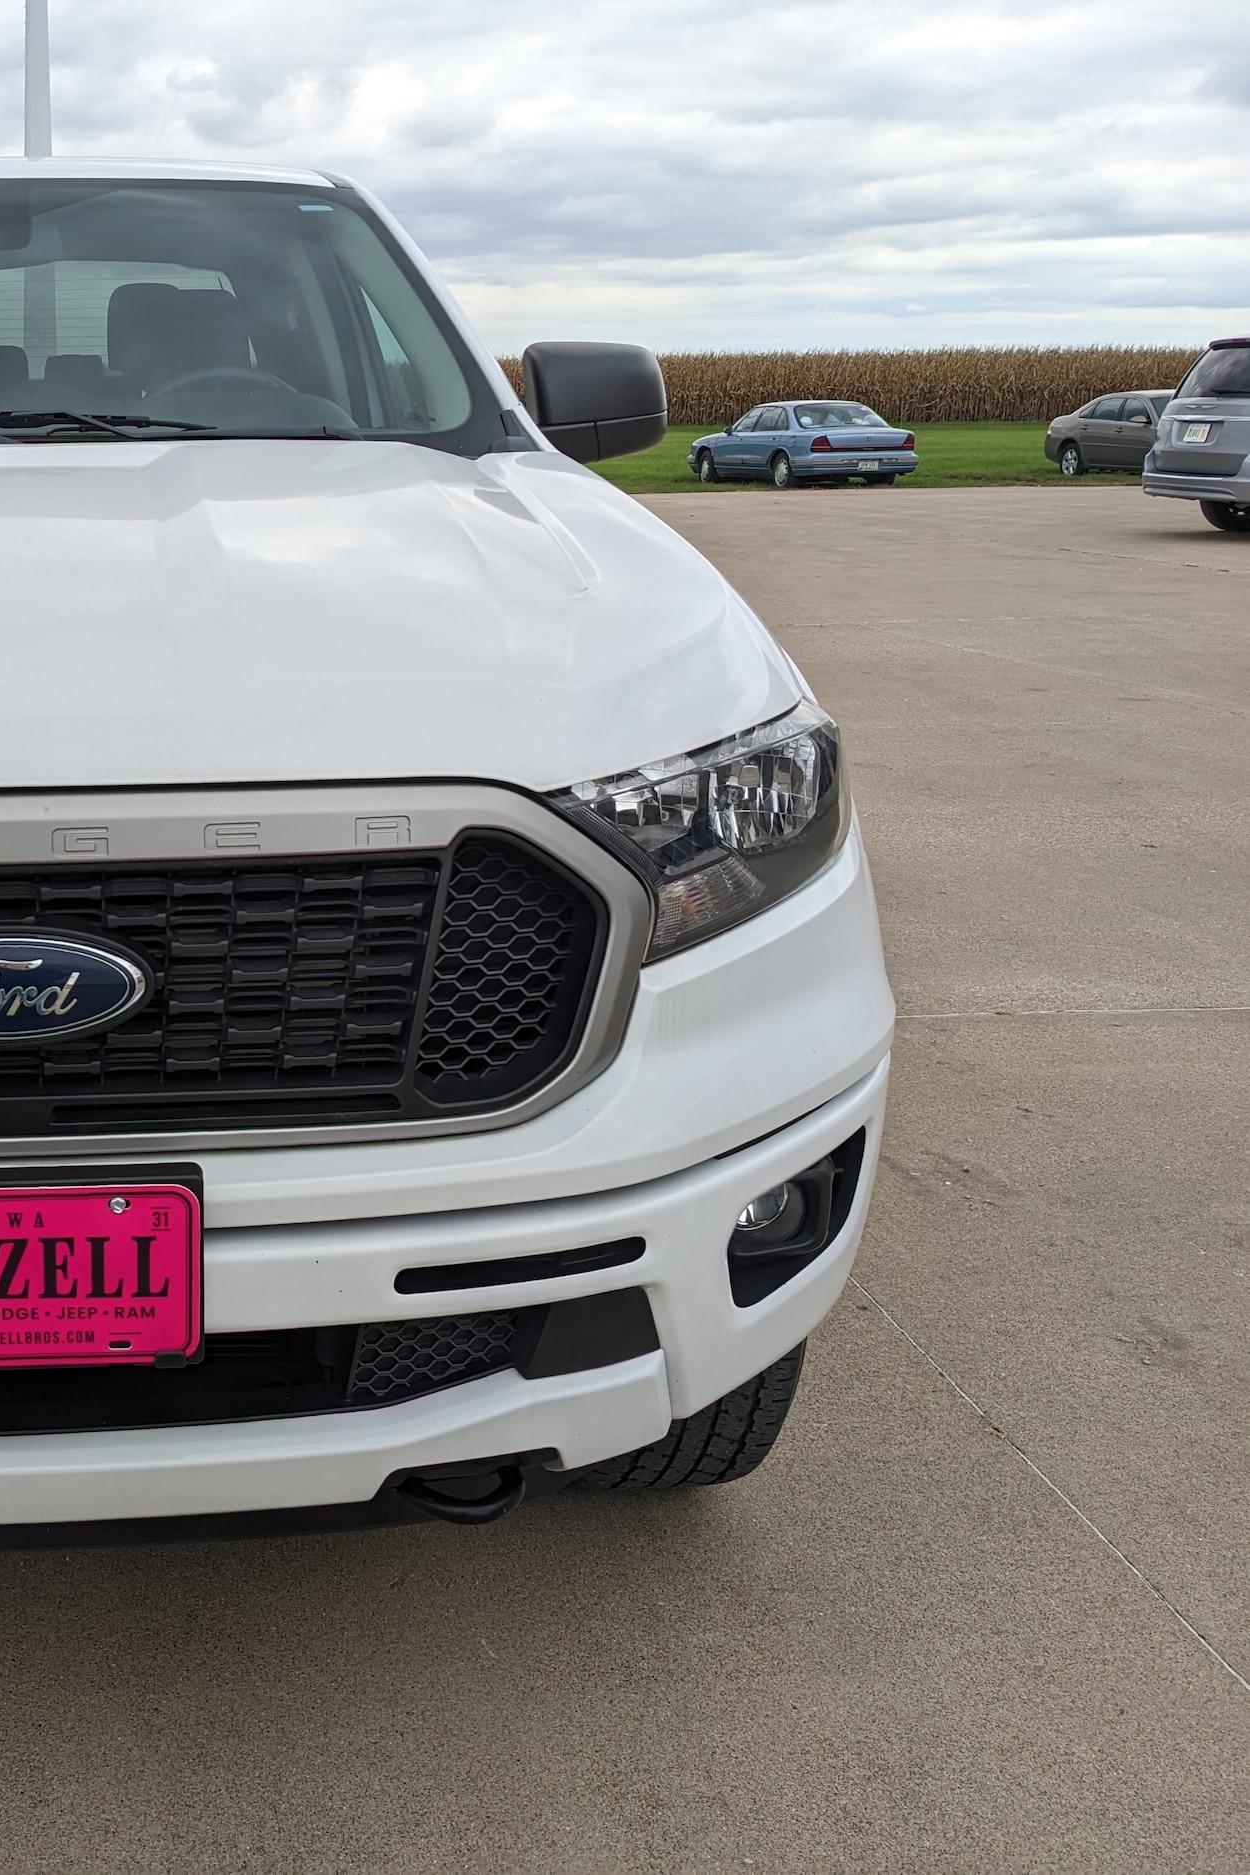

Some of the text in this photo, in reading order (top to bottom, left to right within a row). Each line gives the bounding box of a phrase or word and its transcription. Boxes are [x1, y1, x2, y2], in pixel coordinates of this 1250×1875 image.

[152, 1211, 170, 1228] 31
[56, 1306, 97, 1320] JEEP
[115, 1305, 156, 1319] RAM
